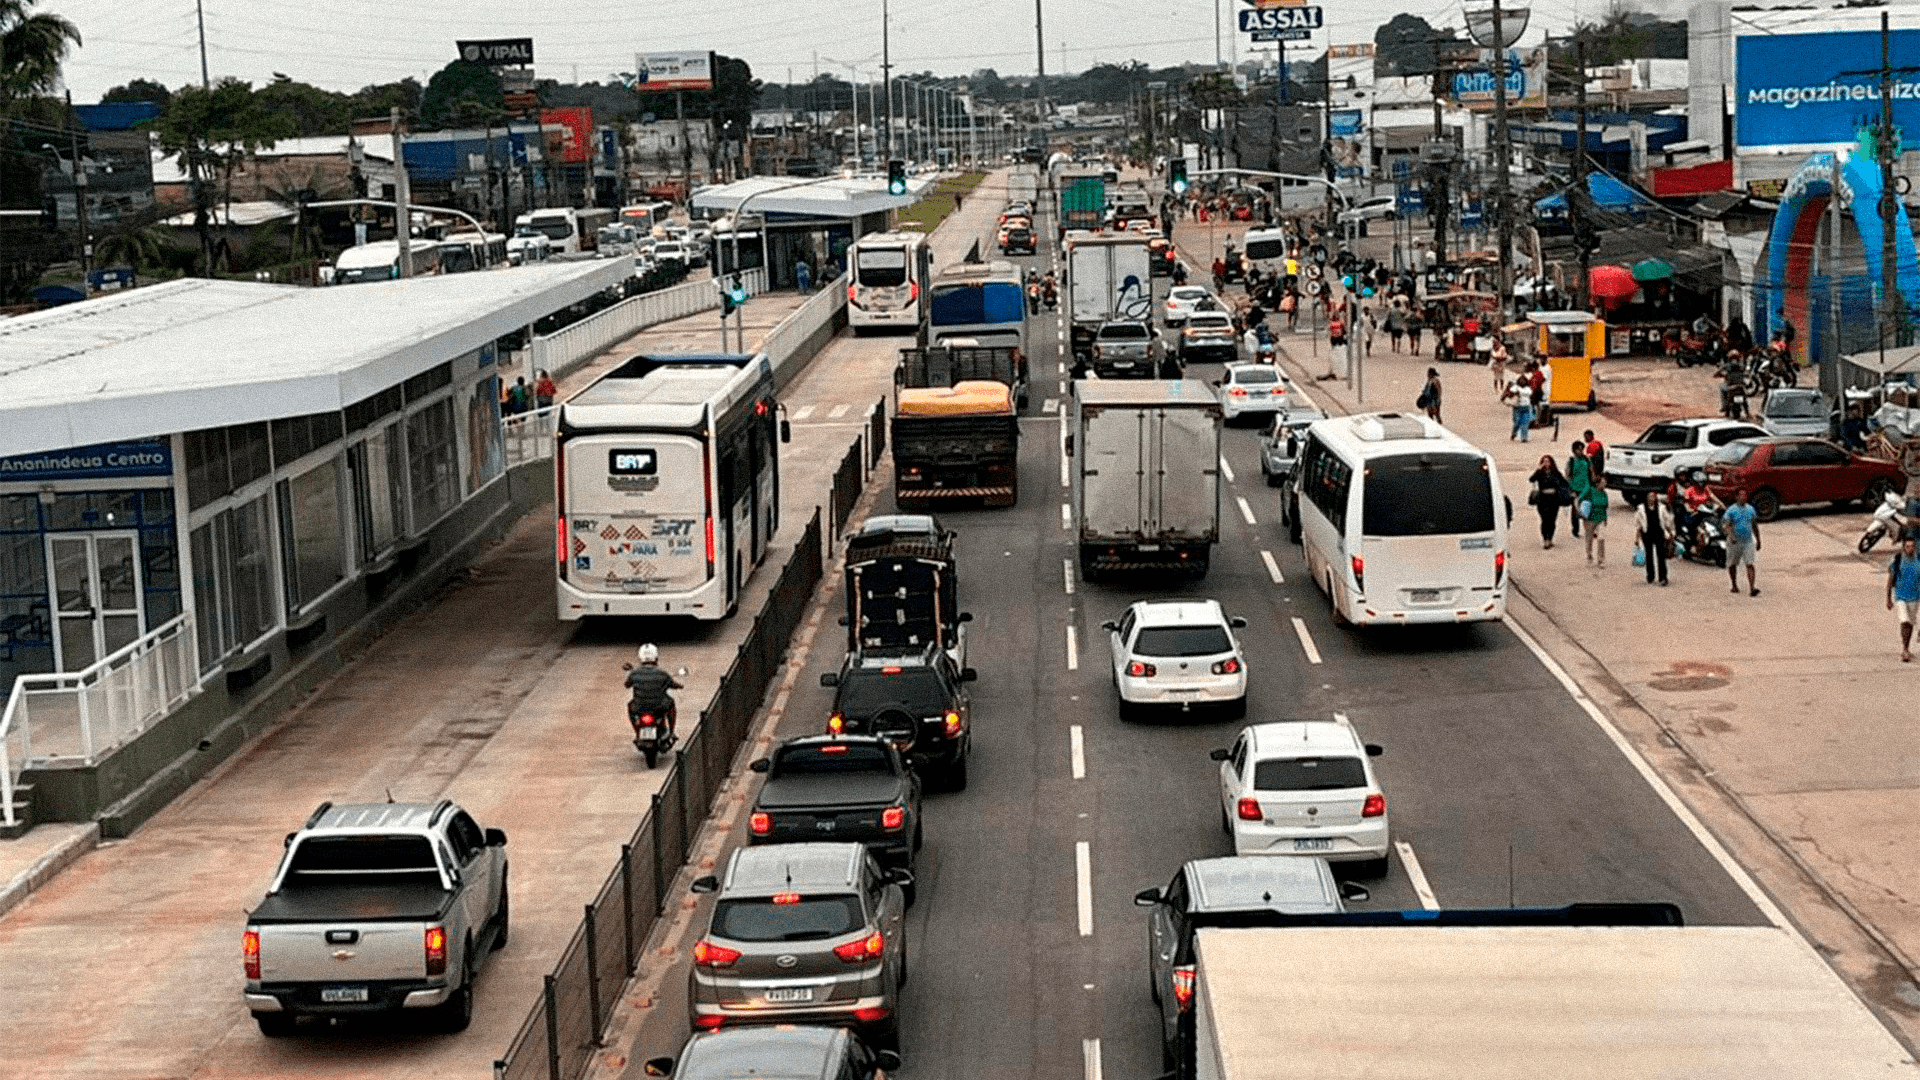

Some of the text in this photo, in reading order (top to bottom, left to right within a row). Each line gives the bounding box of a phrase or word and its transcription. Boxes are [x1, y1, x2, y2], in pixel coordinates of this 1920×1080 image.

[481, 45, 530, 59] VIPAL
[1, 453, 164, 471] Ananindeua Centro
